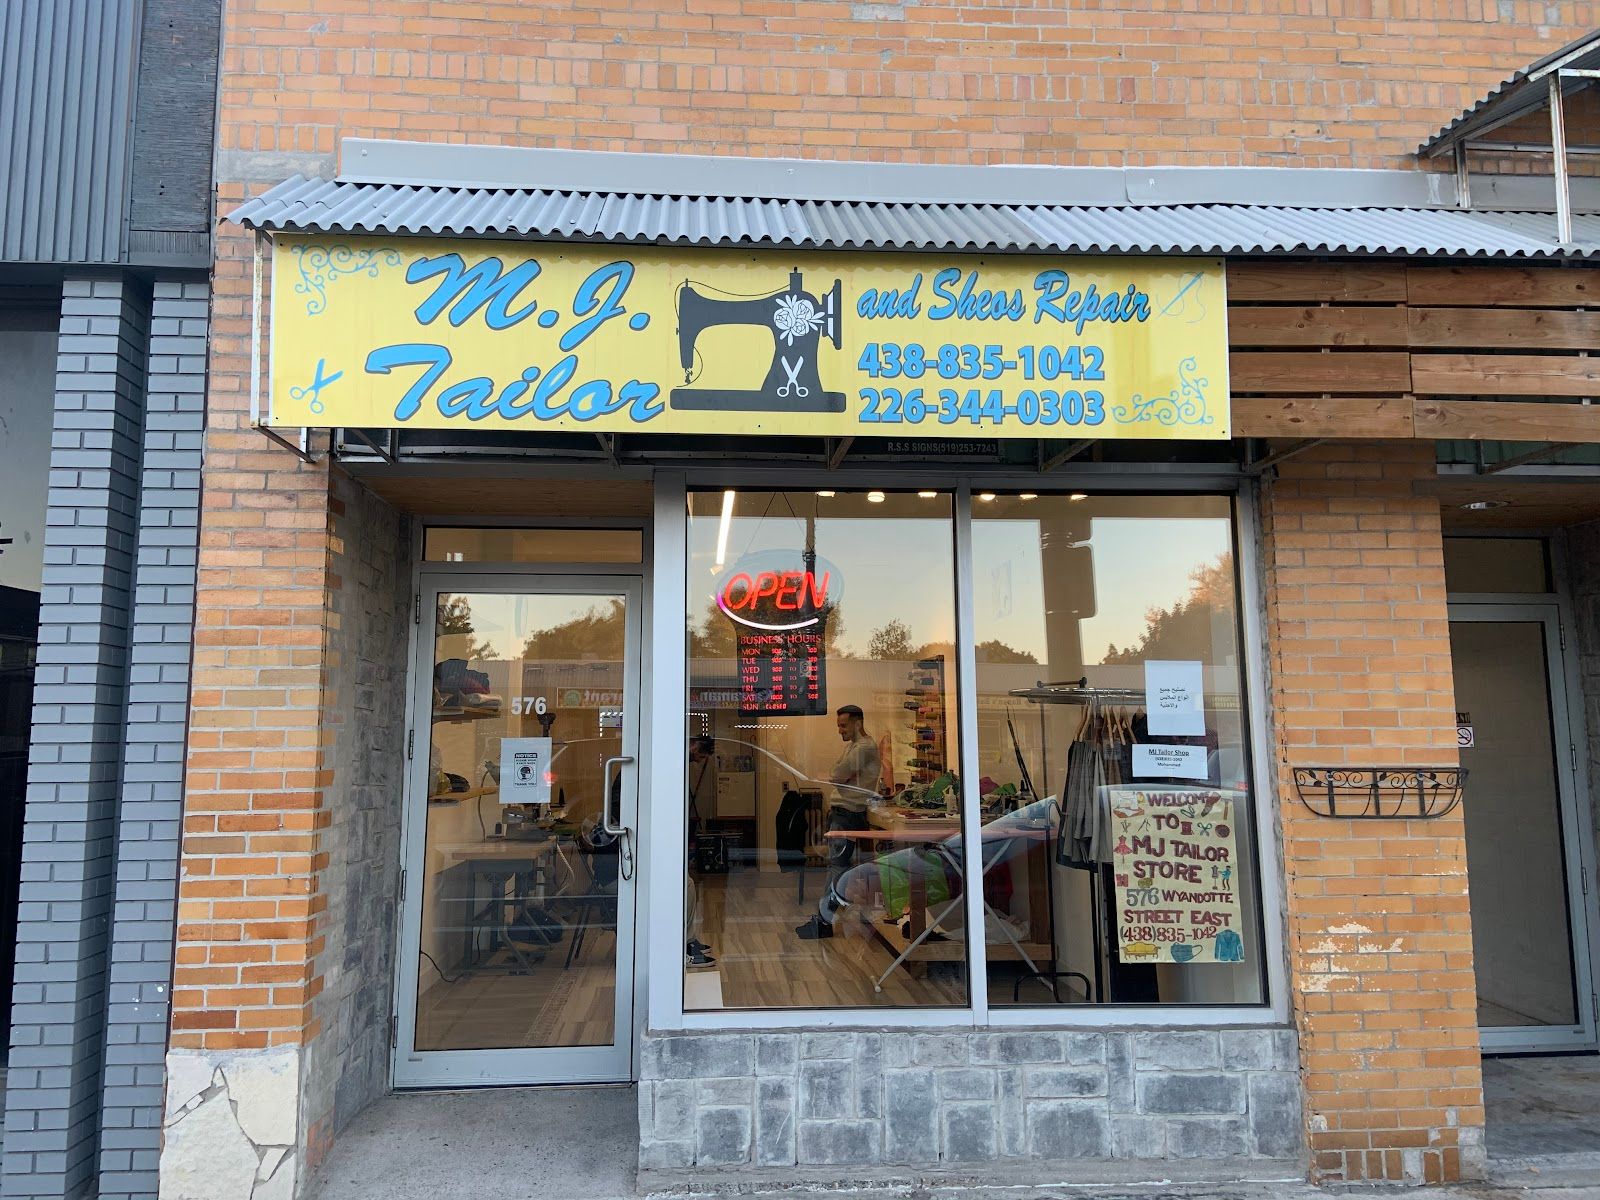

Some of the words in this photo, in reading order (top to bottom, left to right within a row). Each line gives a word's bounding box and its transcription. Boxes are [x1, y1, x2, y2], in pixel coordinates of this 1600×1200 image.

[405, 252, 650, 352] M.J.
[857, 273, 922, 319] and
[928, 267, 1025, 321] Sheos
[1034, 269, 1150, 336] Repair
[857, 343, 1105, 380] 438-835-1042
[364, 343, 665, 423] Tailor
[858, 388, 1106, 425] 226-344-0303
[724, 571, 830, 610] OPEN
[740, 634, 784, 645] BUSINESS
[787, 634, 822, 644] HOURS
[742, 648, 760, 656] MON
[742, 657, 757, 665] TUE
[742, 666, 760, 674] WED
[742, 675, 759, 683] THU
[742, 684, 754, 692] FRI
[511, 696, 547, 715] 576
[742, 694, 756, 702] SAT
[742, 703, 759, 711] SUN
[1174, 749, 1190, 757] Shop
[1152, 813, 1179, 830] TO
[1132, 835, 1165, 857] MJ
[1170, 840, 1229, 862] TAILOR
[1133, 860, 1202, 883] STORE
[1126, 888, 1159, 907] 576
[1162, 889, 1233, 904] WYANDOTTE
[1123, 909, 1184, 924] STREET
[1190, 911, 1232, 926] EAST
[1120, 925, 1217, 943] (438)835-1042
